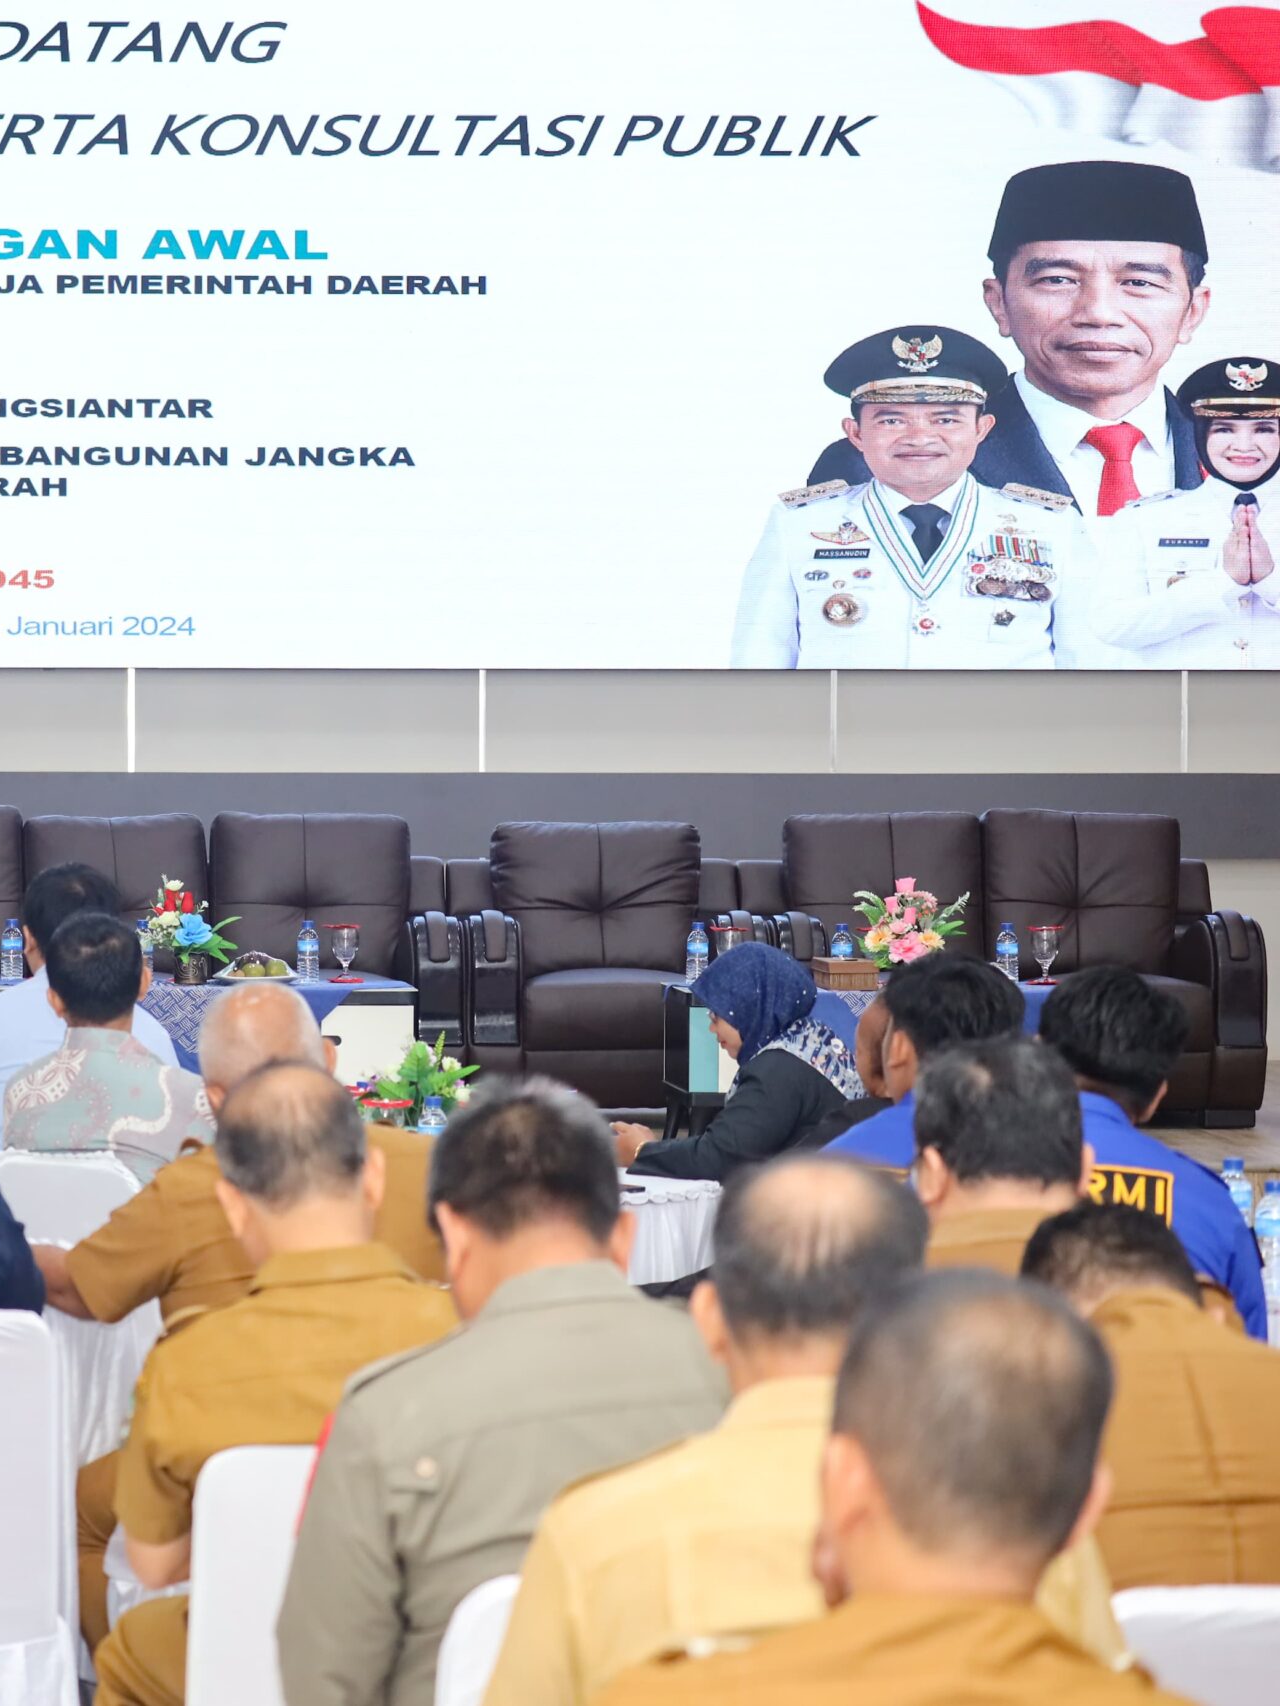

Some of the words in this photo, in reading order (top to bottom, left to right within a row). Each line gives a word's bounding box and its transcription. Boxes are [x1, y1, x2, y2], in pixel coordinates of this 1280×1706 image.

[150, 113, 605, 158] KONSULTASI
[612, 114, 879, 158] PUBLIK
[141, 228, 329, 261] AWAL
[56, 274, 313, 296] PEMERINTAH
[327, 274, 488, 296] DAERAH
[244, 446, 416, 468] JANGKA
[7, 615, 113, 636] Januari
[122, 616, 196, 637] 2024
[1086, 1171, 1166, 1215] RMI
